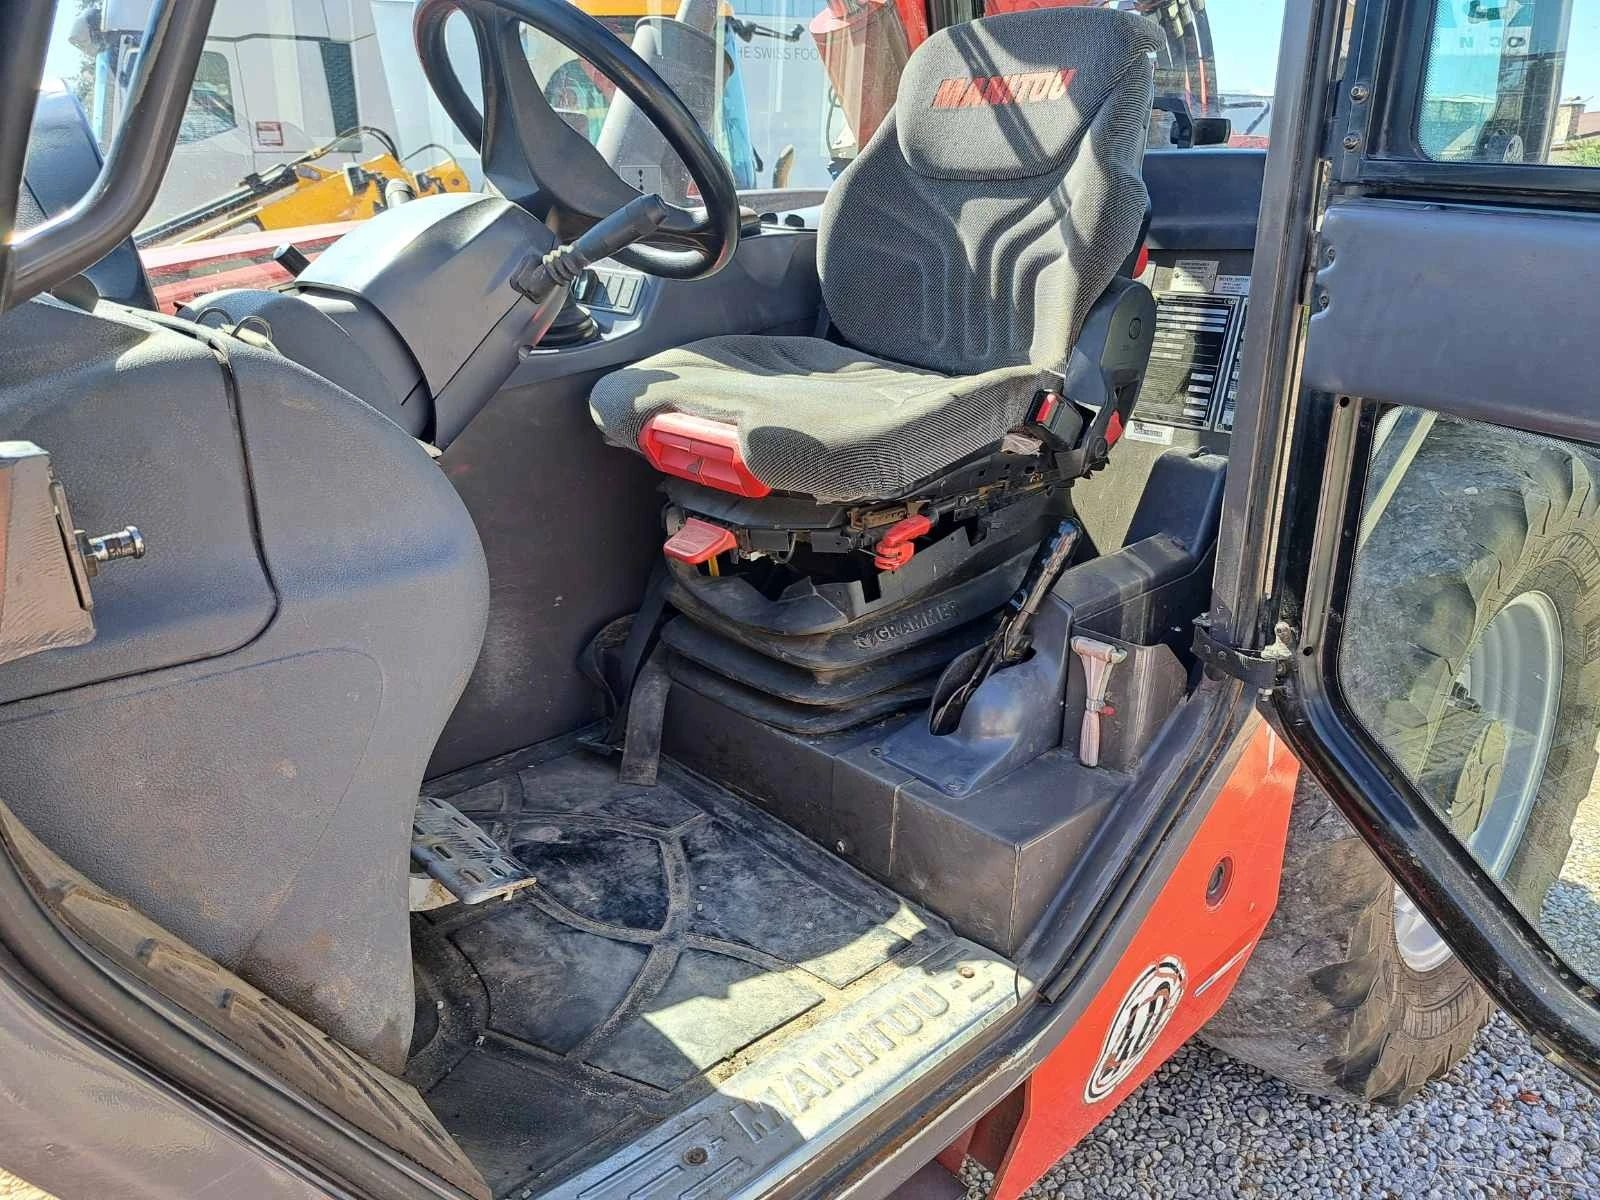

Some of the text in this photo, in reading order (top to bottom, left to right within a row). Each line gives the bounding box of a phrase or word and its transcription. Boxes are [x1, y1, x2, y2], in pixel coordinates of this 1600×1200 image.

[753, 47, 792, 60] SWISS
[931, 67, 1078, 110] MANITOU
[875, 599, 961, 642] GRAMMER
[729, 981, 951, 1145] MANITOU
